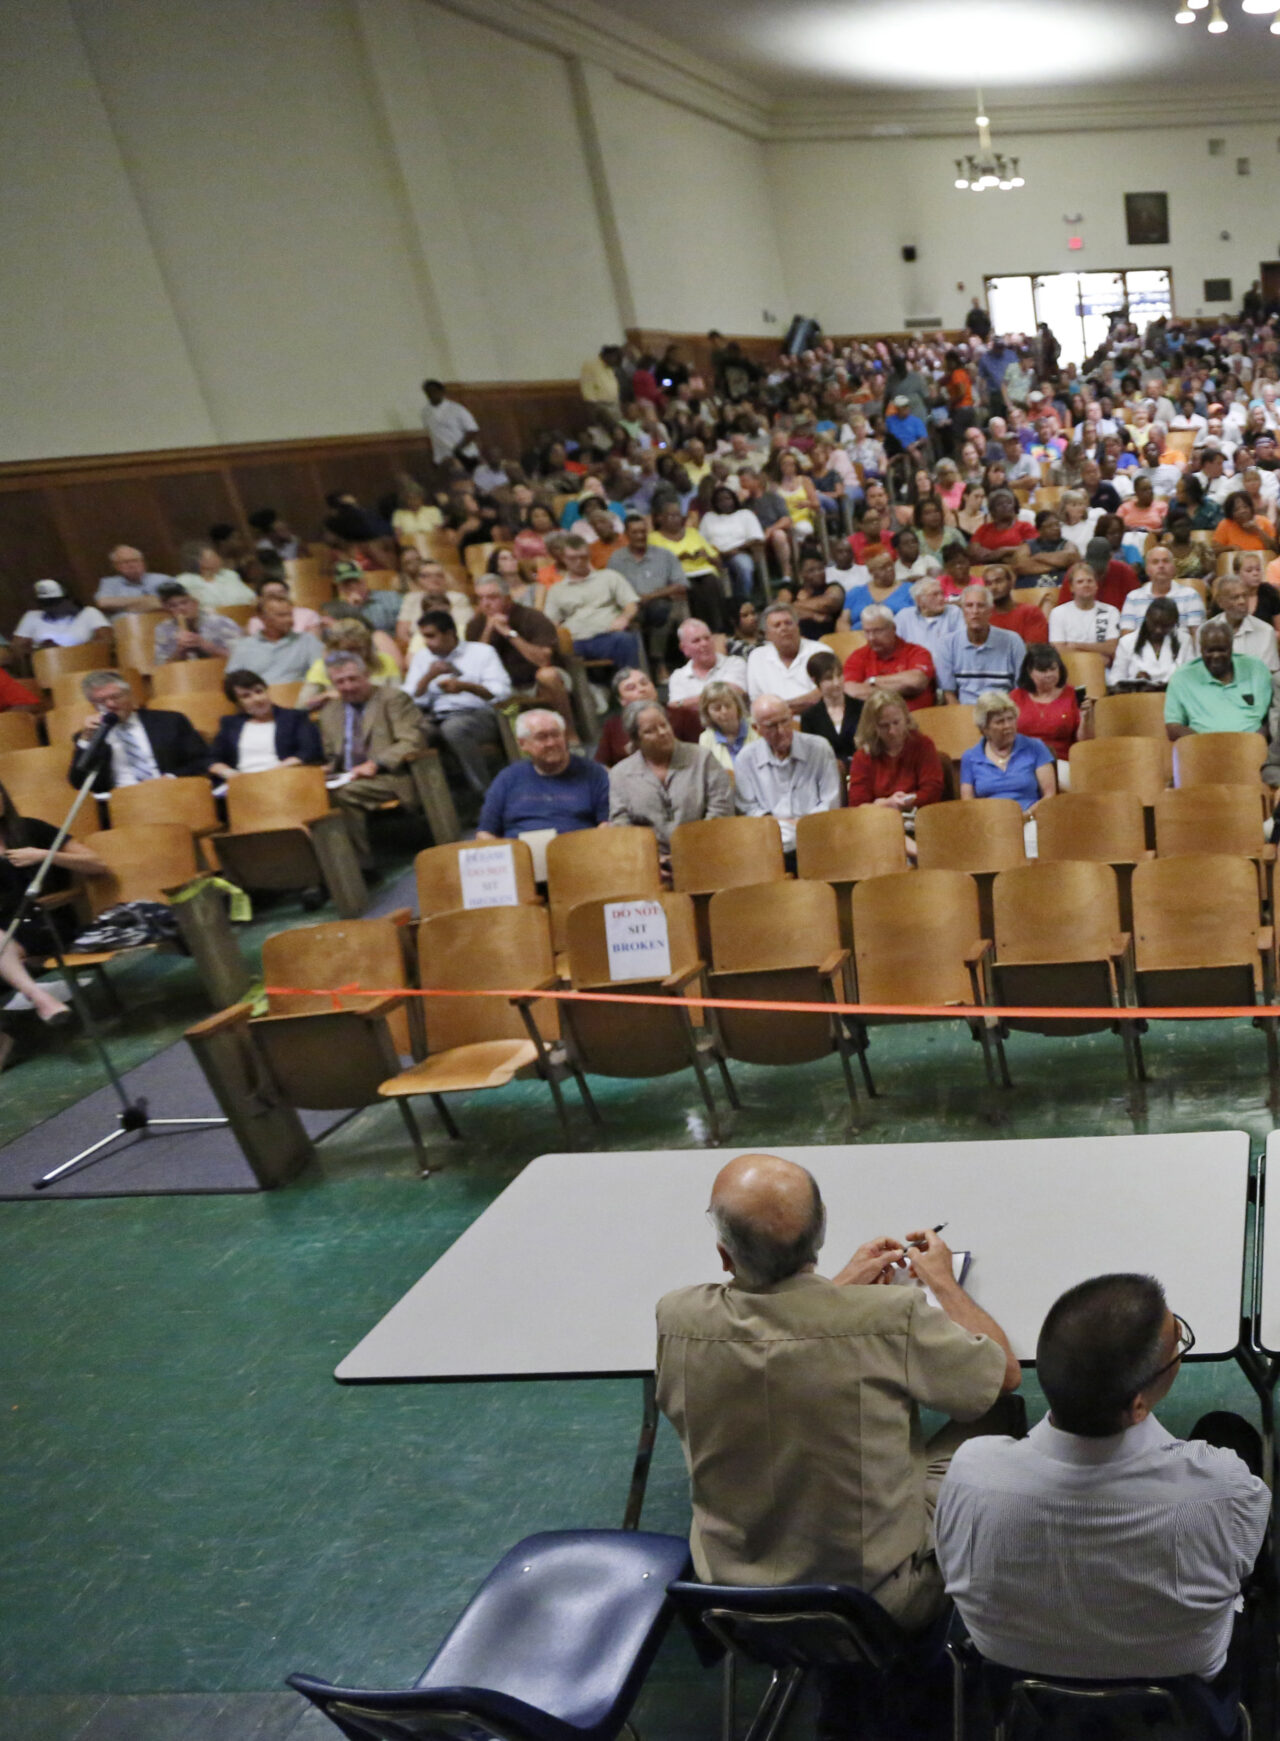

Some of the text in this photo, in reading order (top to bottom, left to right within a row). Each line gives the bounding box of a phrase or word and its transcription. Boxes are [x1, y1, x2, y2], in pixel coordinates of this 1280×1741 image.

[612, 905, 660, 919] DO NOT
[628, 924, 647, 935] SIT
[612, 939, 666, 953] BROKEN
